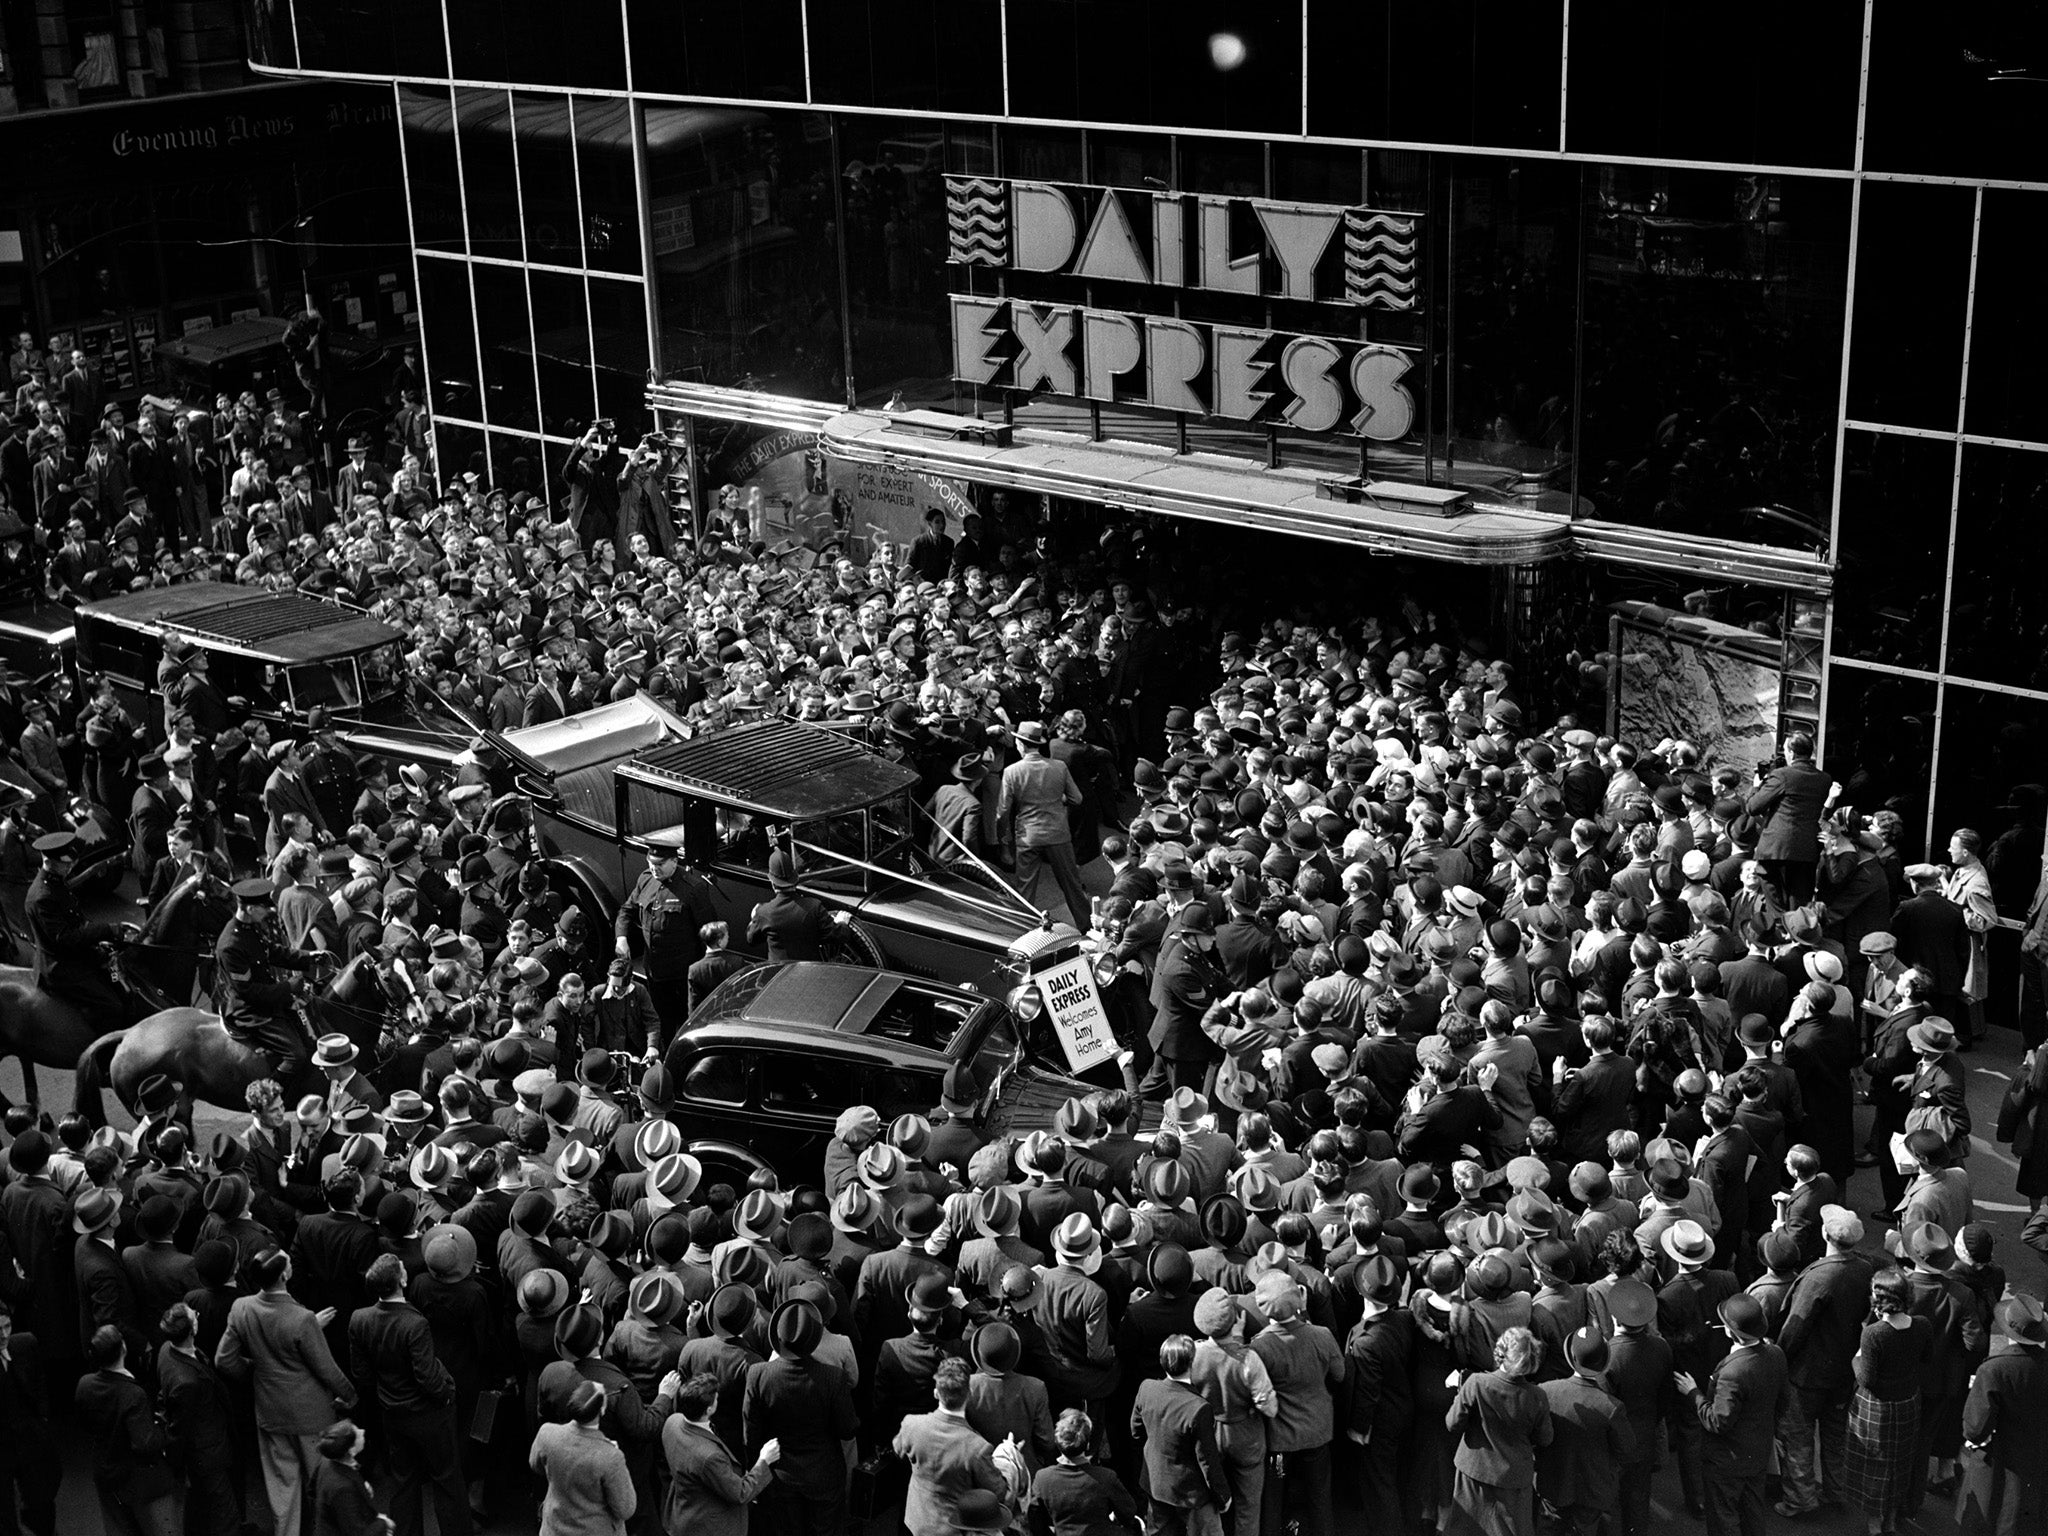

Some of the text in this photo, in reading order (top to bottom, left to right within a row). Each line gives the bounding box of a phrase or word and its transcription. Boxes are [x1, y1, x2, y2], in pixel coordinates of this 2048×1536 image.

[112, 124, 218, 158] Evening
[224, 112, 296, 146] News
[1010, 181, 1346, 302] DAILY
[950, 293, 1417, 443] EXPRESS
[732, 457, 752, 479] THE
[749, 437, 778, 466] DAILY
[857, 473, 876, 486] FOR
[880, 477, 914, 493] EXPERT
[858, 489, 915, 507] AND AMATEUR
[1048, 969, 1078, 994] DAILY
[1051, 985, 1091, 1012] EXPRESS
[1058, 1006, 1098, 1028] Welcomes
[1074, 1024, 1093, 1041] Amy
[1075, 1038, 1102, 1056] Home
